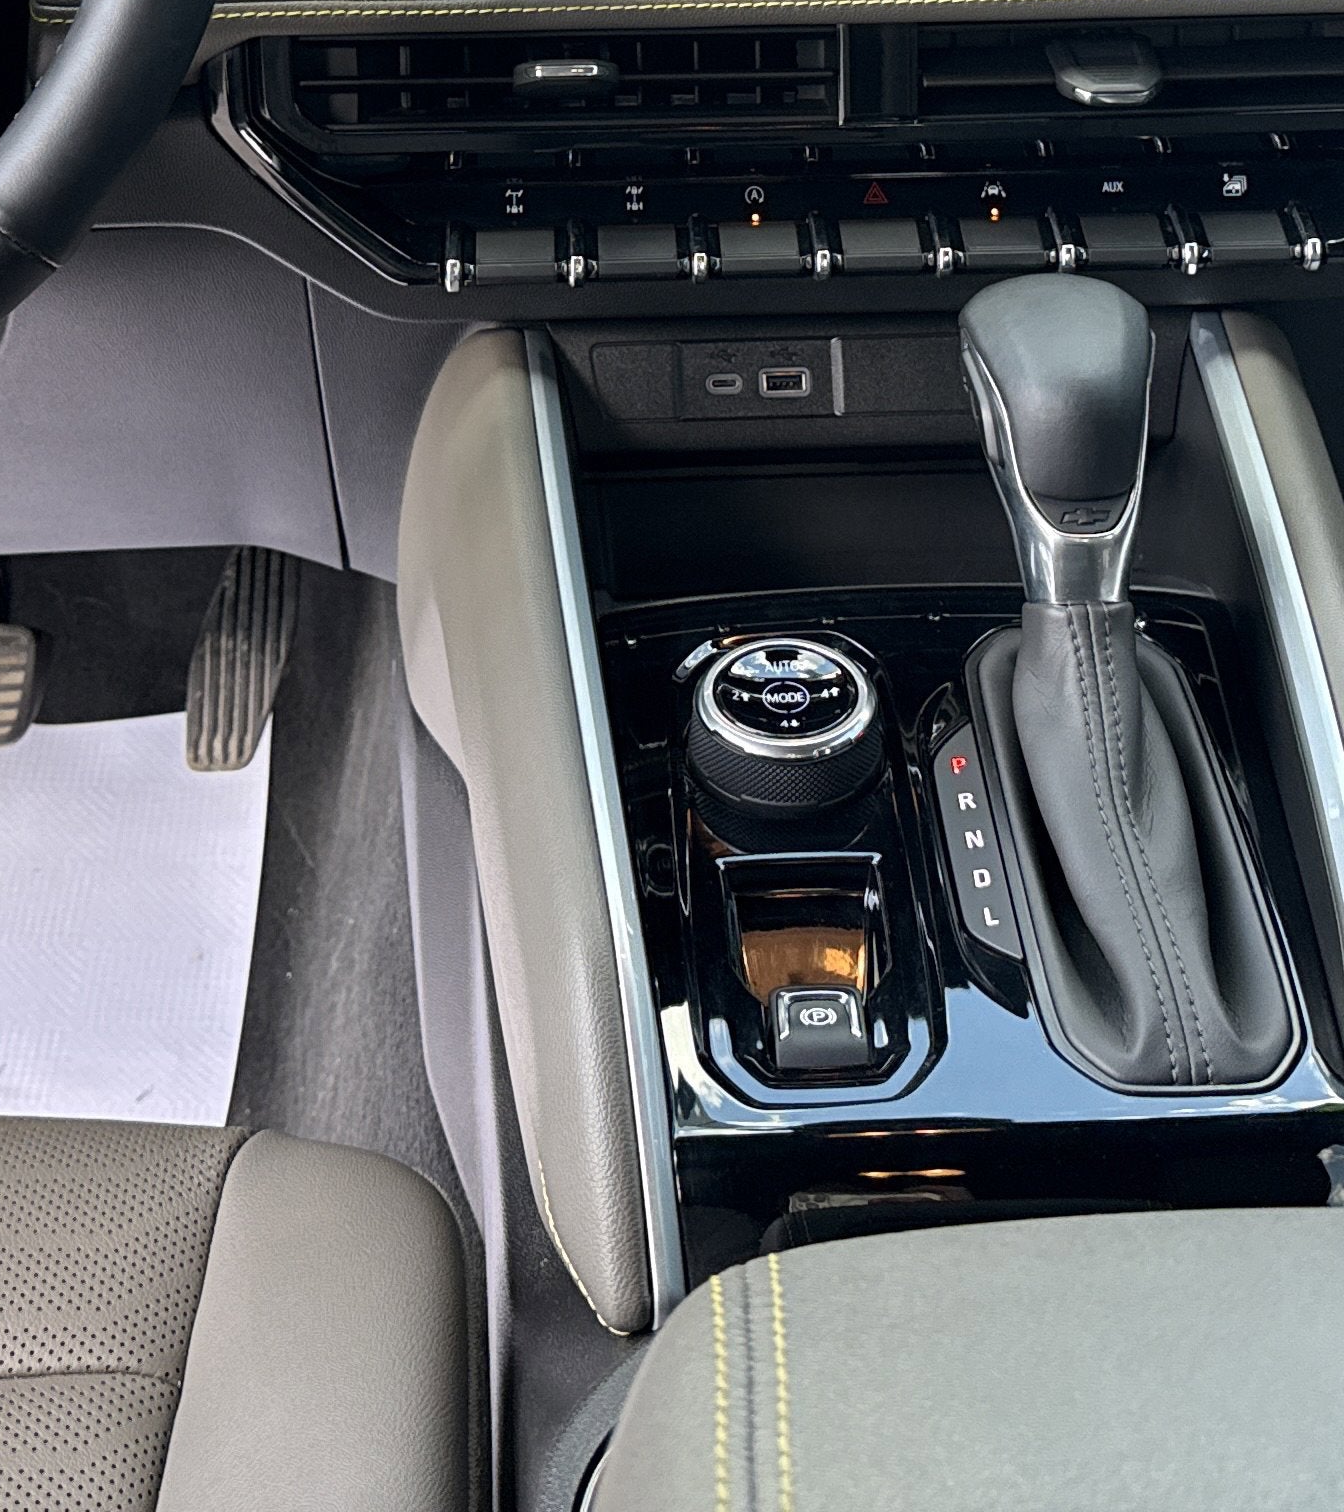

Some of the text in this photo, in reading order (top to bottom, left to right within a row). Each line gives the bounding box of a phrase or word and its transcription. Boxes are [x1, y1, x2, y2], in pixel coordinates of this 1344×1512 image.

[1102, 181, 1124, 192] AUX
[766, 691, 805, 704] MODE
[951, 756, 967, 773] P
[958, 792, 977, 811] R
[965, 831, 984, 849] N
[972, 869, 992, 888] D
[983, 907, 999, 927] L
